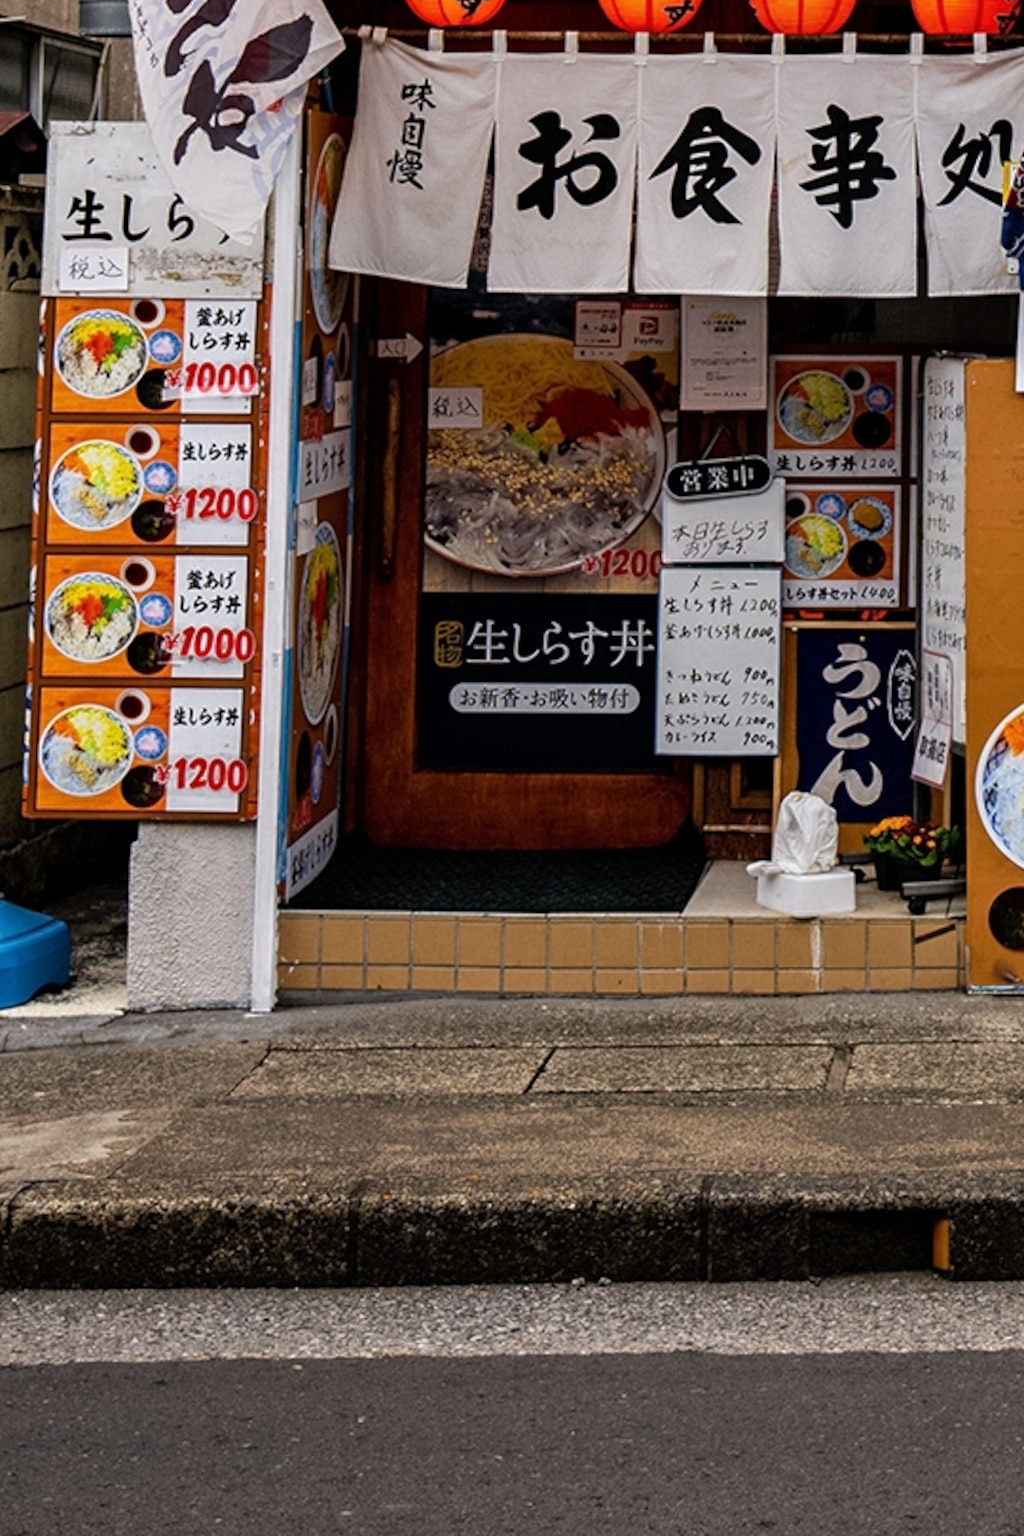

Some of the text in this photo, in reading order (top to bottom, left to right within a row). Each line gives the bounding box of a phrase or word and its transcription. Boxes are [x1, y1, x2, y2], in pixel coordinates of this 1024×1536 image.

[387, 77, 436, 192] 味自慢
[516, 103, 1012, 230] お食事処
[61, 188, 230, 245] 生しら
[68, 253, 124, 281] 税込
[188, 331, 251, 352] しらす丼
[633, 336, 664, 346] PayPay
[164, 361, 260, 395] ¥1000
[182, 441, 249, 463] 生しらす丼
[775, 455, 857, 472] 生しらす丼
[680, 464, 755, 494] 営業中
[165, 486, 257, 523] ¥1200
[582, 548, 661, 580] ¥1200
[689, 574, 759, 594] メニュー
[782, 587, 859, 602] しらす丼セット
[178, 593, 242, 615] しらす丼
[664, 595, 731, 616] 生しらす丼
[161, 624, 255, 663] ¥1000
[466, 618, 655, 668] 生しらす丼
[173, 706, 240, 728] 生しらす丼
[810, 642, 884, 807] うどん
[154, 756, 248, 794] ¥1200
